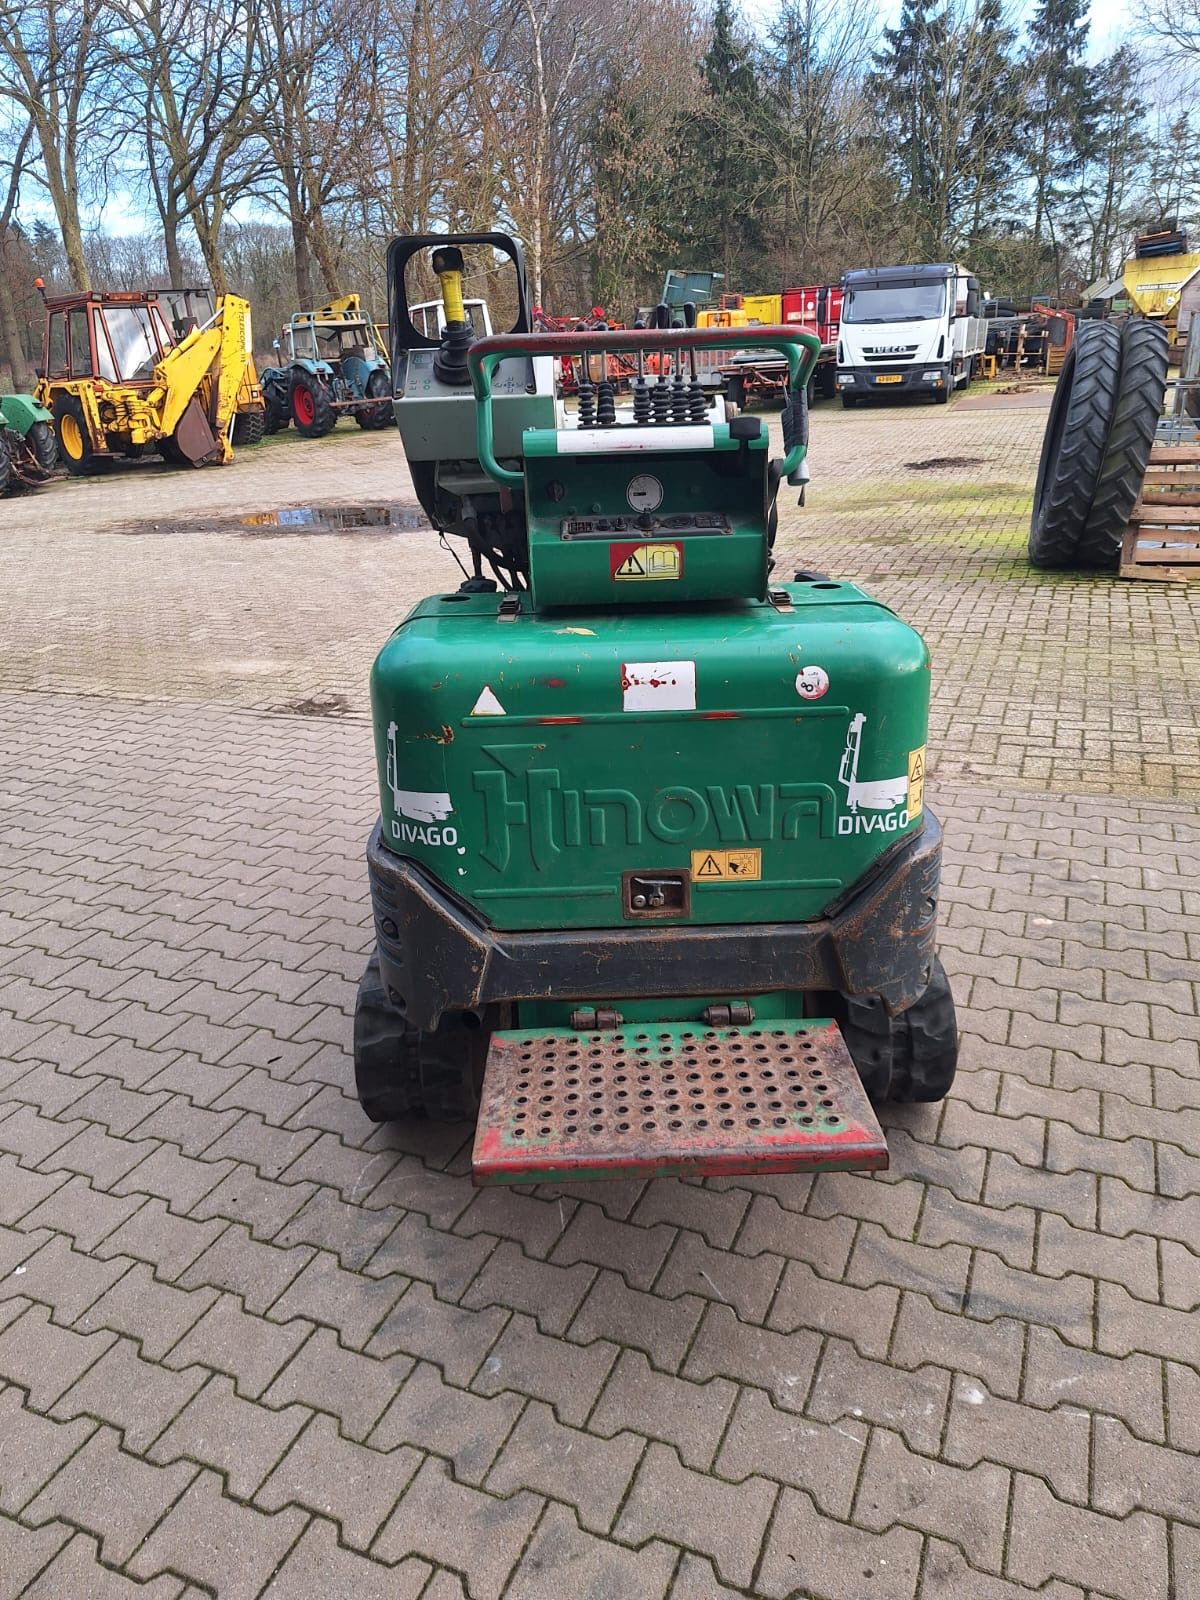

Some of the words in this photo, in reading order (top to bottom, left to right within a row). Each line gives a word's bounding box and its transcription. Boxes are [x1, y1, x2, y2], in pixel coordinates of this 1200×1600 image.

[873, 346, 907, 354] IVECO
[391, 820, 458, 846] DIVAGO
[838, 809, 909, 835] DIVAGO
